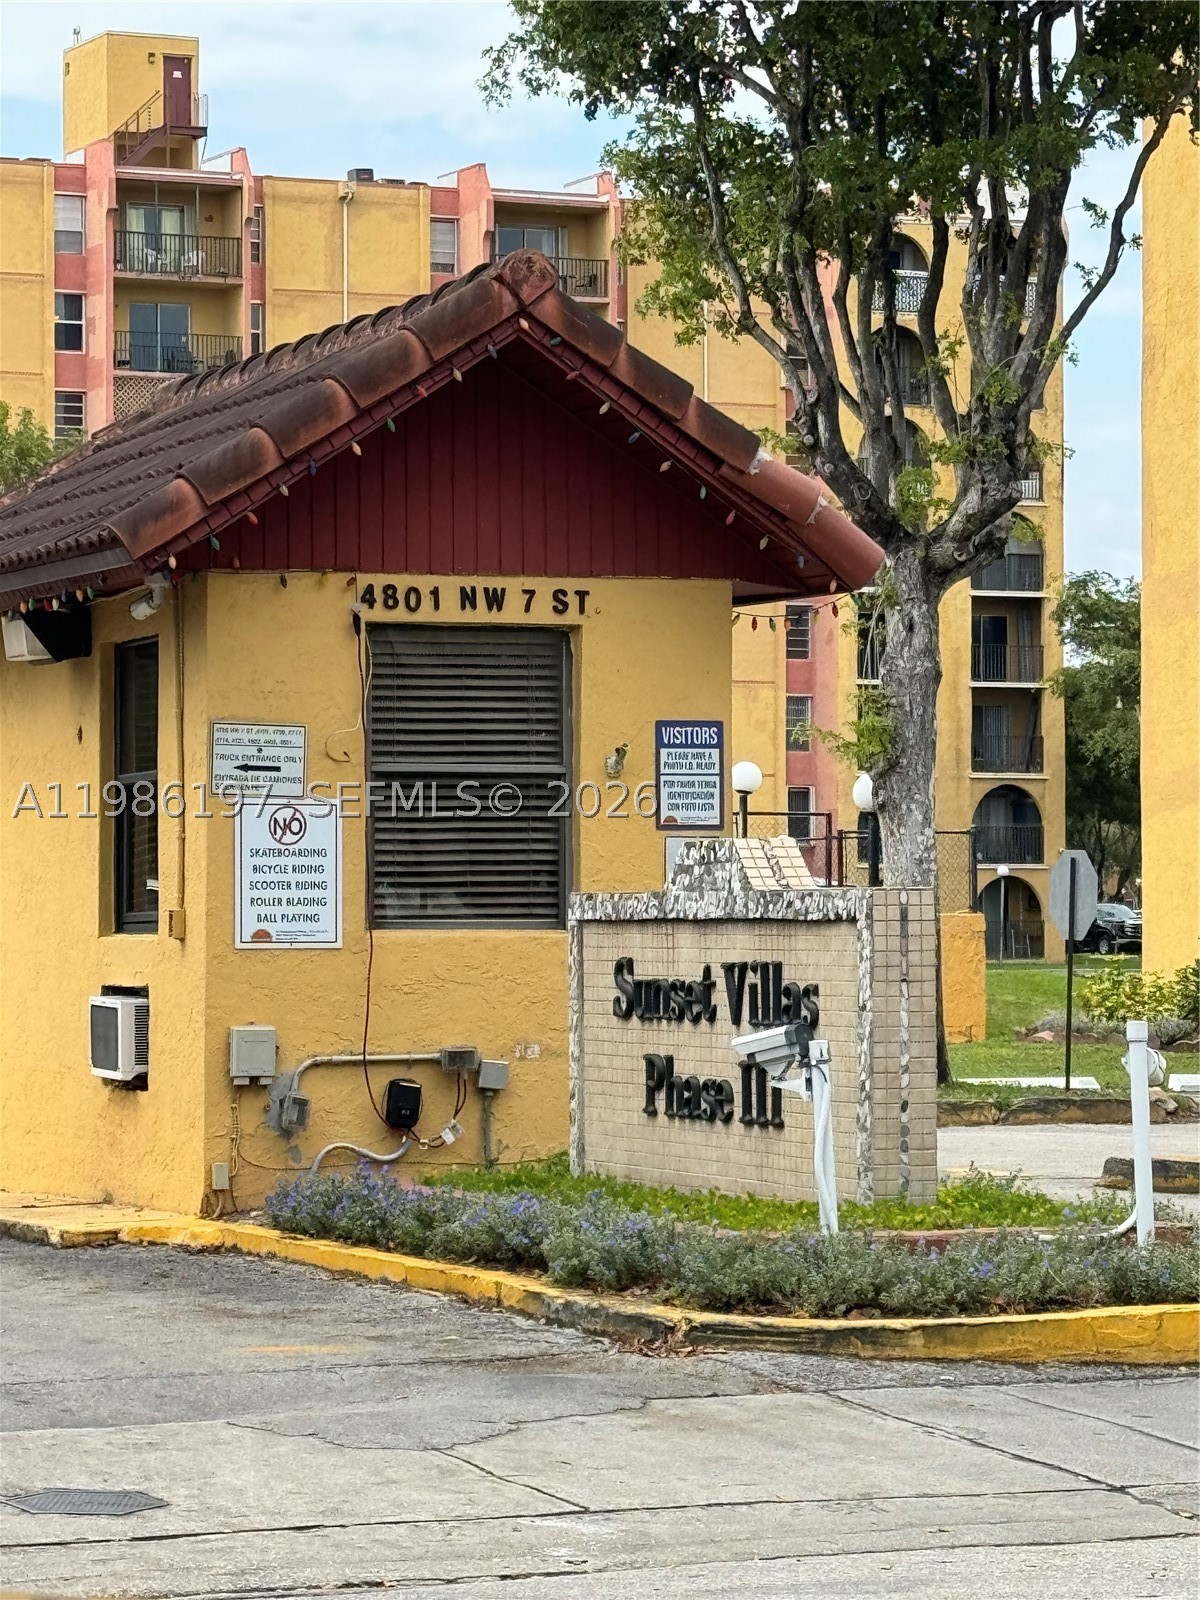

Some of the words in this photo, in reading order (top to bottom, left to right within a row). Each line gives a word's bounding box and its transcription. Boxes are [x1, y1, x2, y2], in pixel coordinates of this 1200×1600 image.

[360, 583, 440, 612] 4801
[459, 585, 506, 613] NW
[521, 589, 536, 613] 7
[552, 588, 590, 615] ST
[662, 726, 718, 745] VISITORS
[215, 753, 240, 761] TRUCK
[241, 754, 282, 763] ENTRANCE
[283, 755, 302, 764] ONLY
[666, 751, 690, 761] PLEASE
[691, 751, 706, 761] HAVE
[708, 752, 713, 761] A
[663, 761, 684, 771] PHOTO
[696, 761, 716, 771] READY
[214, 774, 248, 782] ENTRADA
[250, 775, 261, 783] DE
[262, 776, 303, 784] CAMIONES
[663, 780, 676, 789] POR
[677, 780, 696, 789] FAVOR
[697, 780, 717, 789] TENGA
[667, 802, 681, 812] CON
[681, 802, 697, 812] FOTO
[698, 803, 715, 812] LISTA
[273, 817, 303, 836] NO
[249, 848, 328, 858] SKATEBOARDING
[252, 864, 289, 874] BICYCLE
[292, 864, 325, 874] RIDING
[249, 881, 292, 890] SCOOTER
[295, 881, 328, 891] RIDING
[250, 897, 283, 907] ROLLER
[286, 897, 327, 907] BLADING
[257, 913, 278, 923] BALL
[281, 913, 320, 923] PLAYING
[612, 956, 717, 1024] Sunset
[720, 959, 820, 1029] Villas
[642, 1053, 735, 1123] Phase
